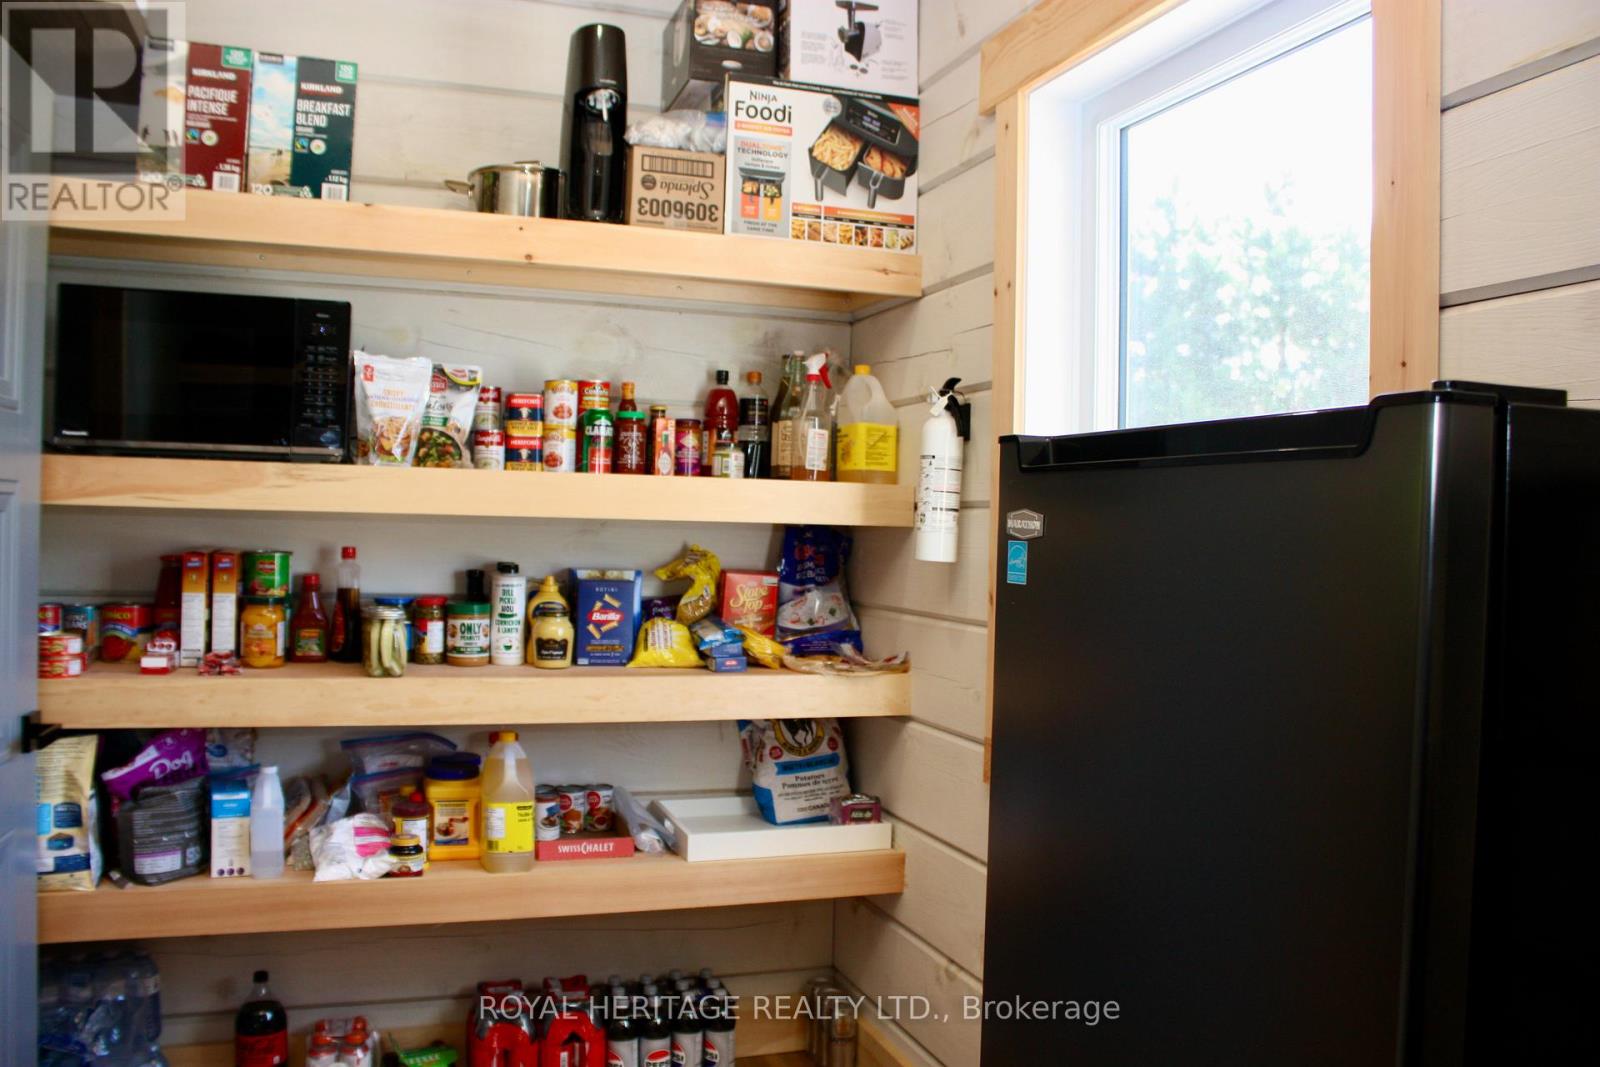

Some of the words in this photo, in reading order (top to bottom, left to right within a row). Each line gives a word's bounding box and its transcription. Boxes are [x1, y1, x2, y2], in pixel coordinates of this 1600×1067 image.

[191, 67, 237, 81] KIRKLAND
[187, 84, 239, 104] PACIFIQUE
[300, 82, 343, 95] KIRKLAND
[749, 89, 778, 104] NINJA
[186, 98, 229, 116] INTENSE
[297, 99, 351, 117] BREAKFAST
[734, 99, 792, 124] Foodi
[295, 112, 328, 128] BLEND
[737, 147, 789, 159] TECHNOLOGY
[659, 180, 715, 200] Splenda
[637, 197, 719, 222] 3096003
[460, 622, 482, 635] ONLY
[149, 750, 194, 780] Dog
